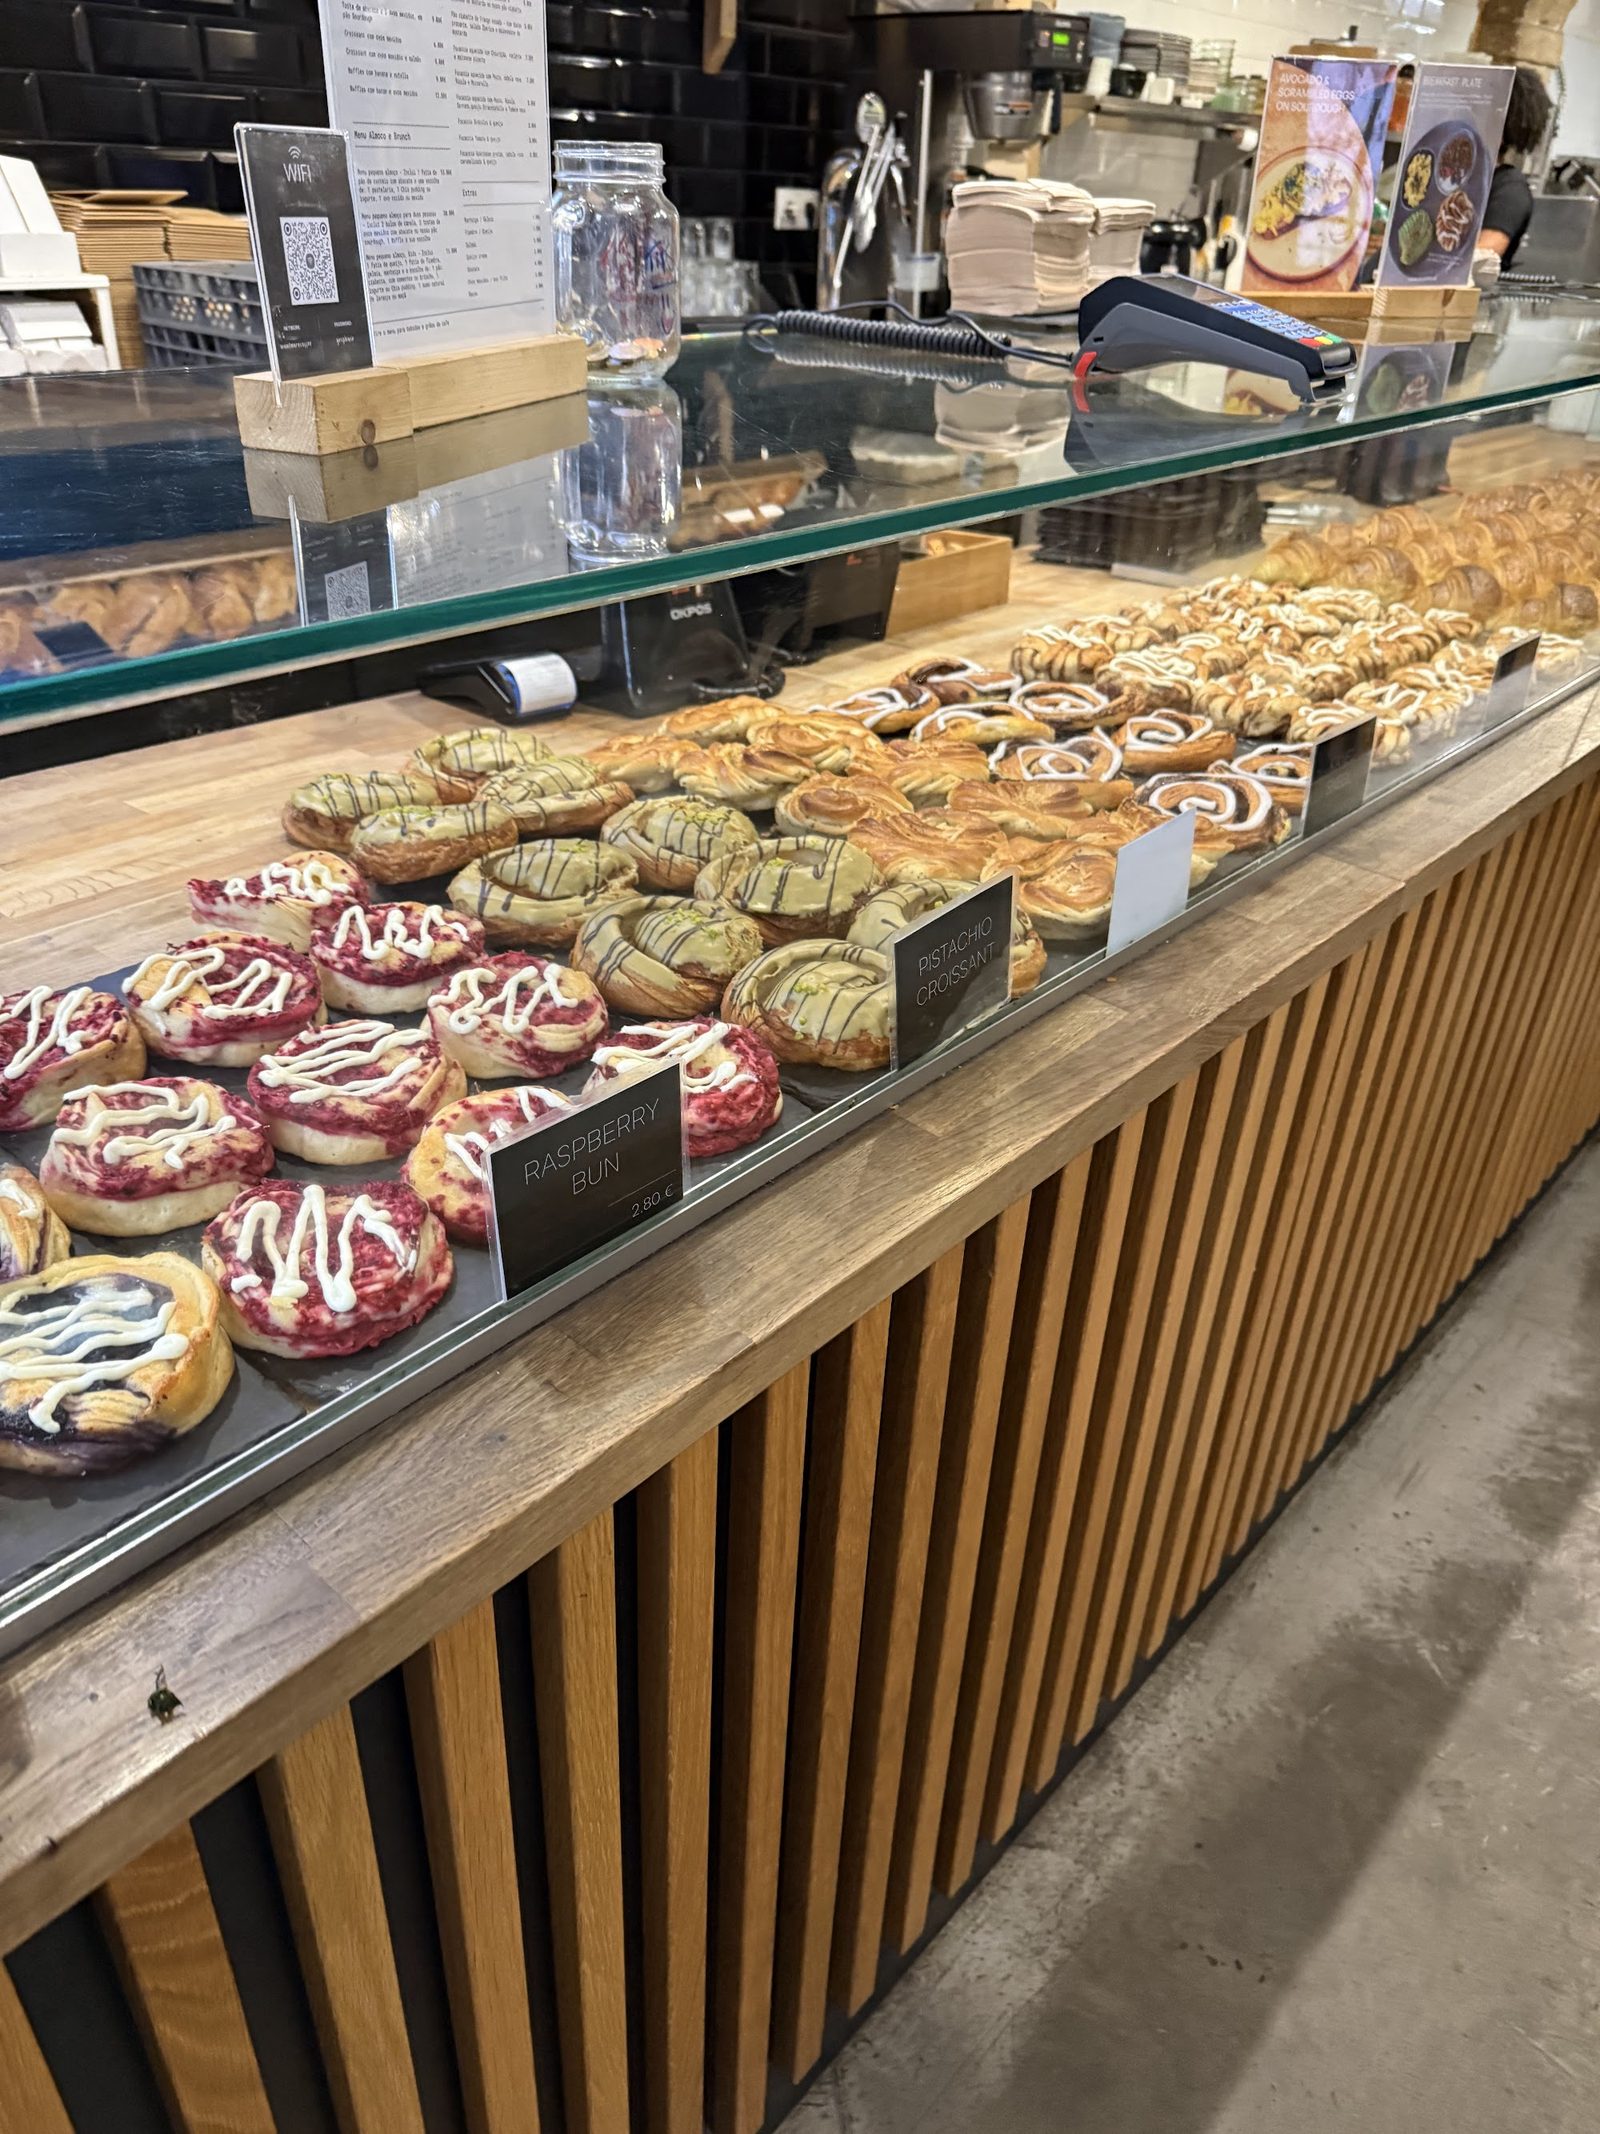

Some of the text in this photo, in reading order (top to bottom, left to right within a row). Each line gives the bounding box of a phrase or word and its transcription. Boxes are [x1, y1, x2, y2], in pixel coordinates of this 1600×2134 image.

[1280, 73, 1323, 85] AVOCADO
[1462, 77, 1484, 89] PLATE
[1277, 88, 1356, 100] SCRAMBLED EGGS
[1276, 101, 1289, 111] ON
[393, 131, 411, 141] Brunch
[283, 163, 312, 183] WIFI
[462, 189, 477, 197] Extras
[919, 916, 993, 977] PISTACHIO
[916, 941, 996, 1006] CROISSANT
[524, 1098, 659, 1185] RASPBERRY
[572, 1151, 620, 1195] BUN
[631, 1183, 674, 1218] 2.80 €
